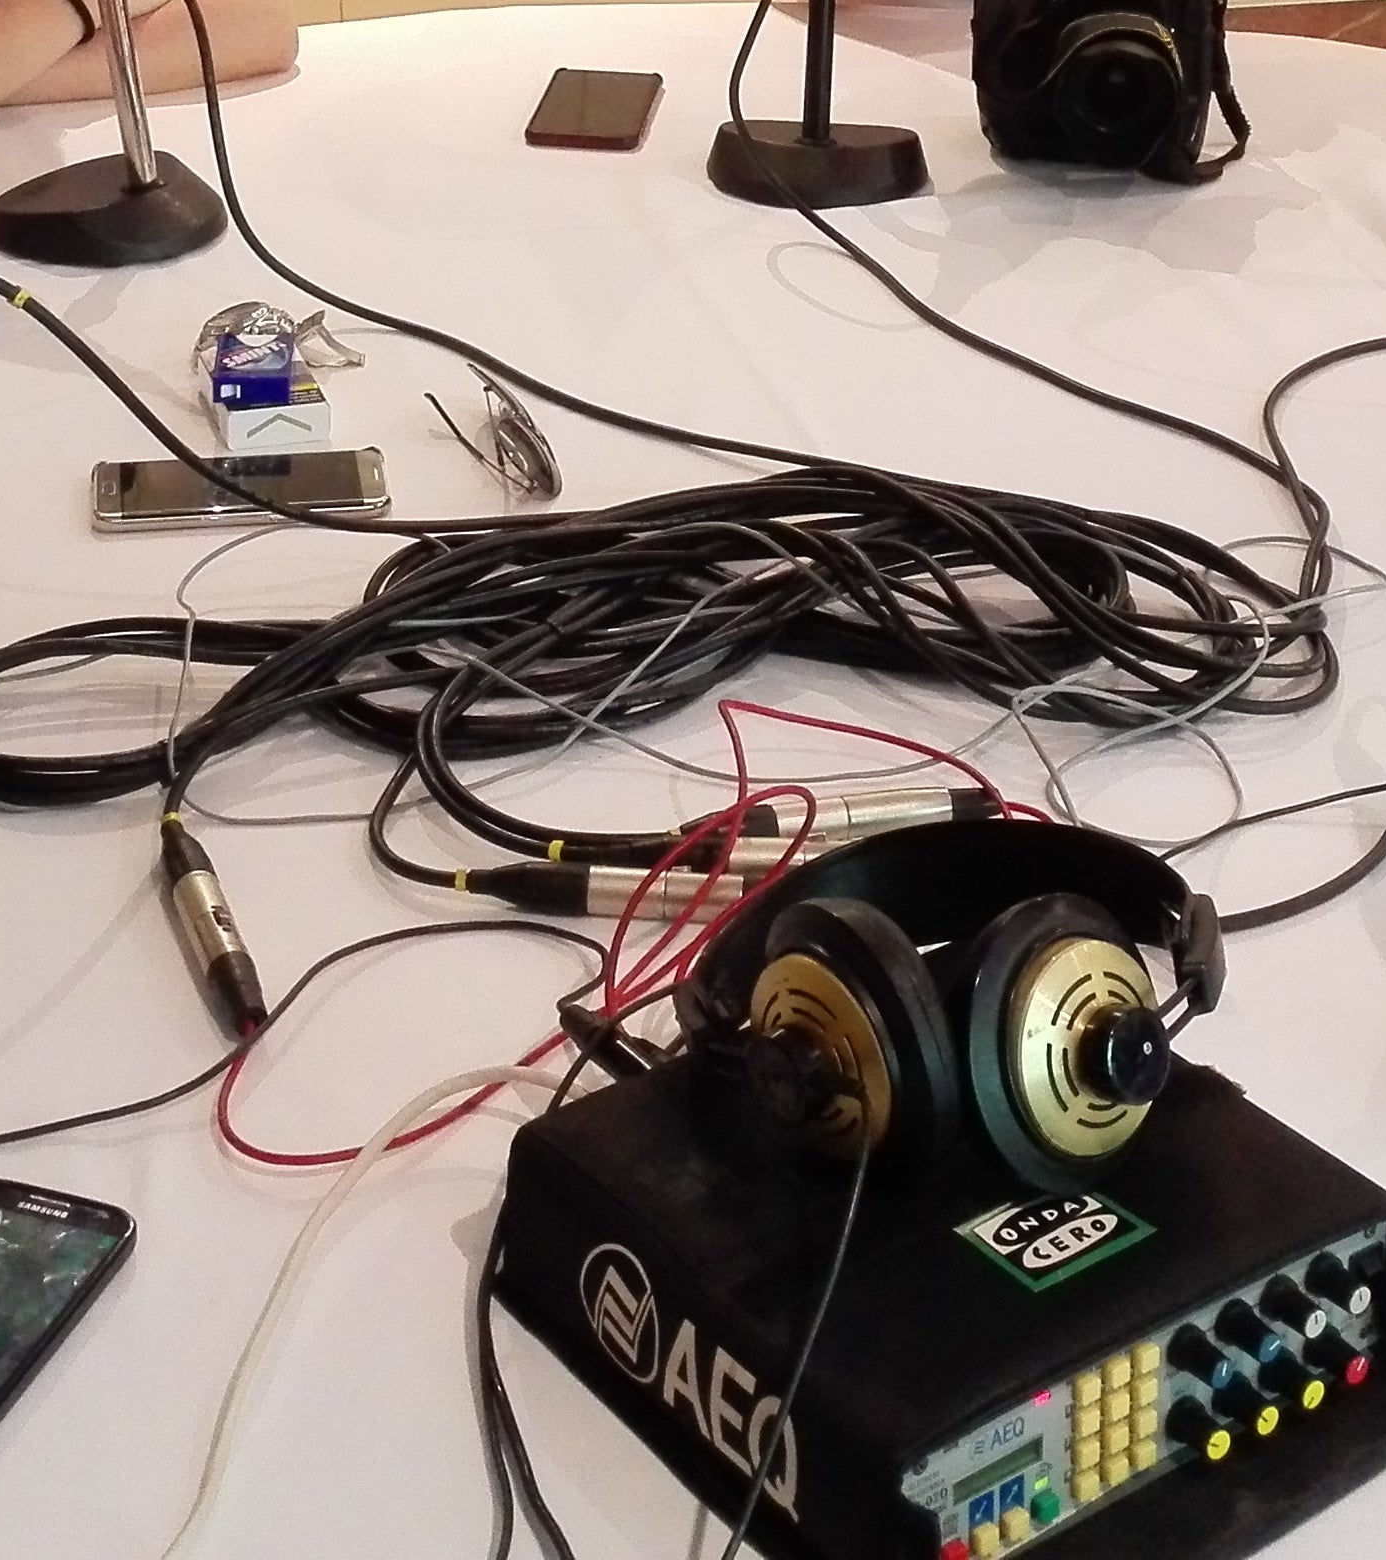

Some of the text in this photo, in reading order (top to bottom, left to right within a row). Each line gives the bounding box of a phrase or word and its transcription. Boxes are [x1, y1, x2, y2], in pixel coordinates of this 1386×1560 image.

[17, 1201, 69, 1219] SAMSUNG
[1000, 1201, 1081, 1241] ONDA
[1032, 1219, 1106, 1260] CERO
[663, 1318, 799, 1523] AEQ
[990, 1416, 1025, 1451] AEQ
